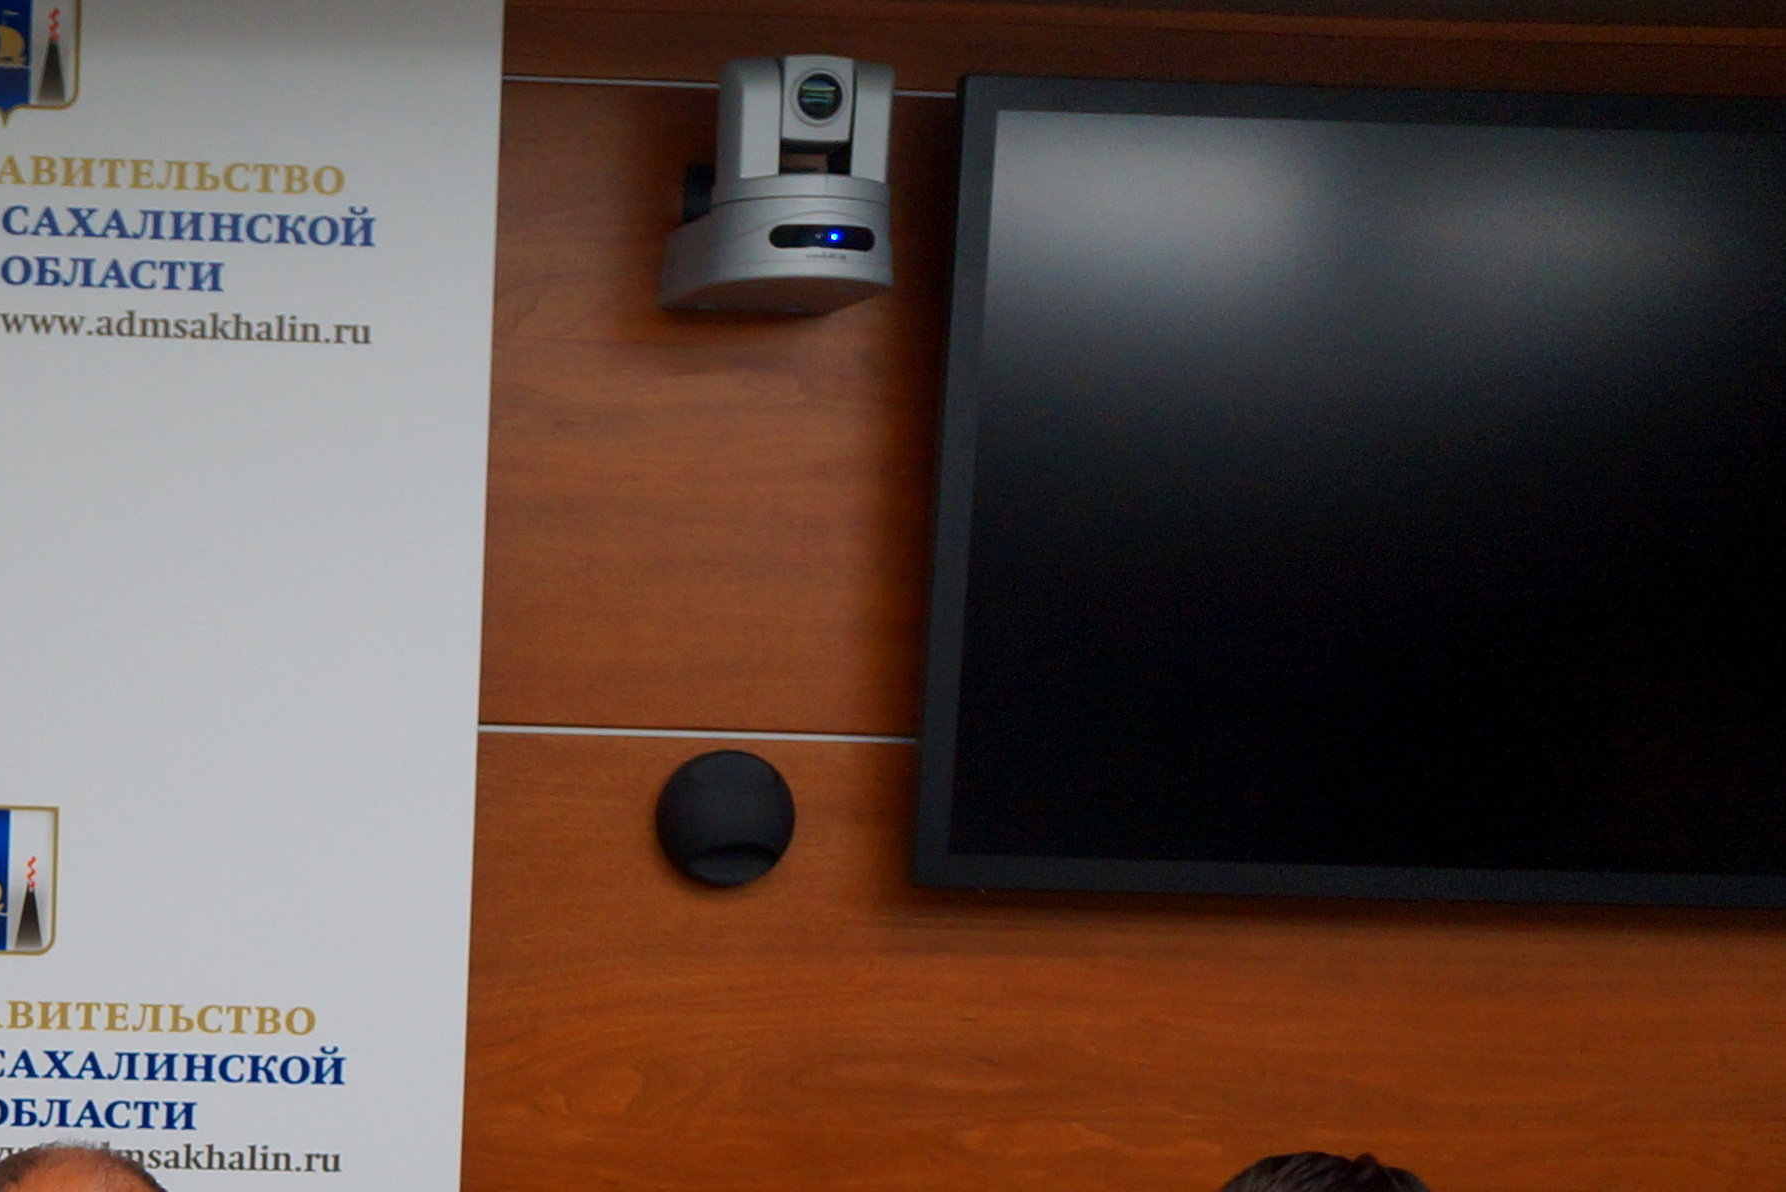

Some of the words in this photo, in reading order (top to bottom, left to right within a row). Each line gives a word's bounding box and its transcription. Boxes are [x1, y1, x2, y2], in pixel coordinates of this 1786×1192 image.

[2, 206, 374, 246] САХАЛИНСКОЙ
[0, 256, 223, 291] ОБЛАСТИ
[0, 310, 370, 344] www.admsakhalin.ru
